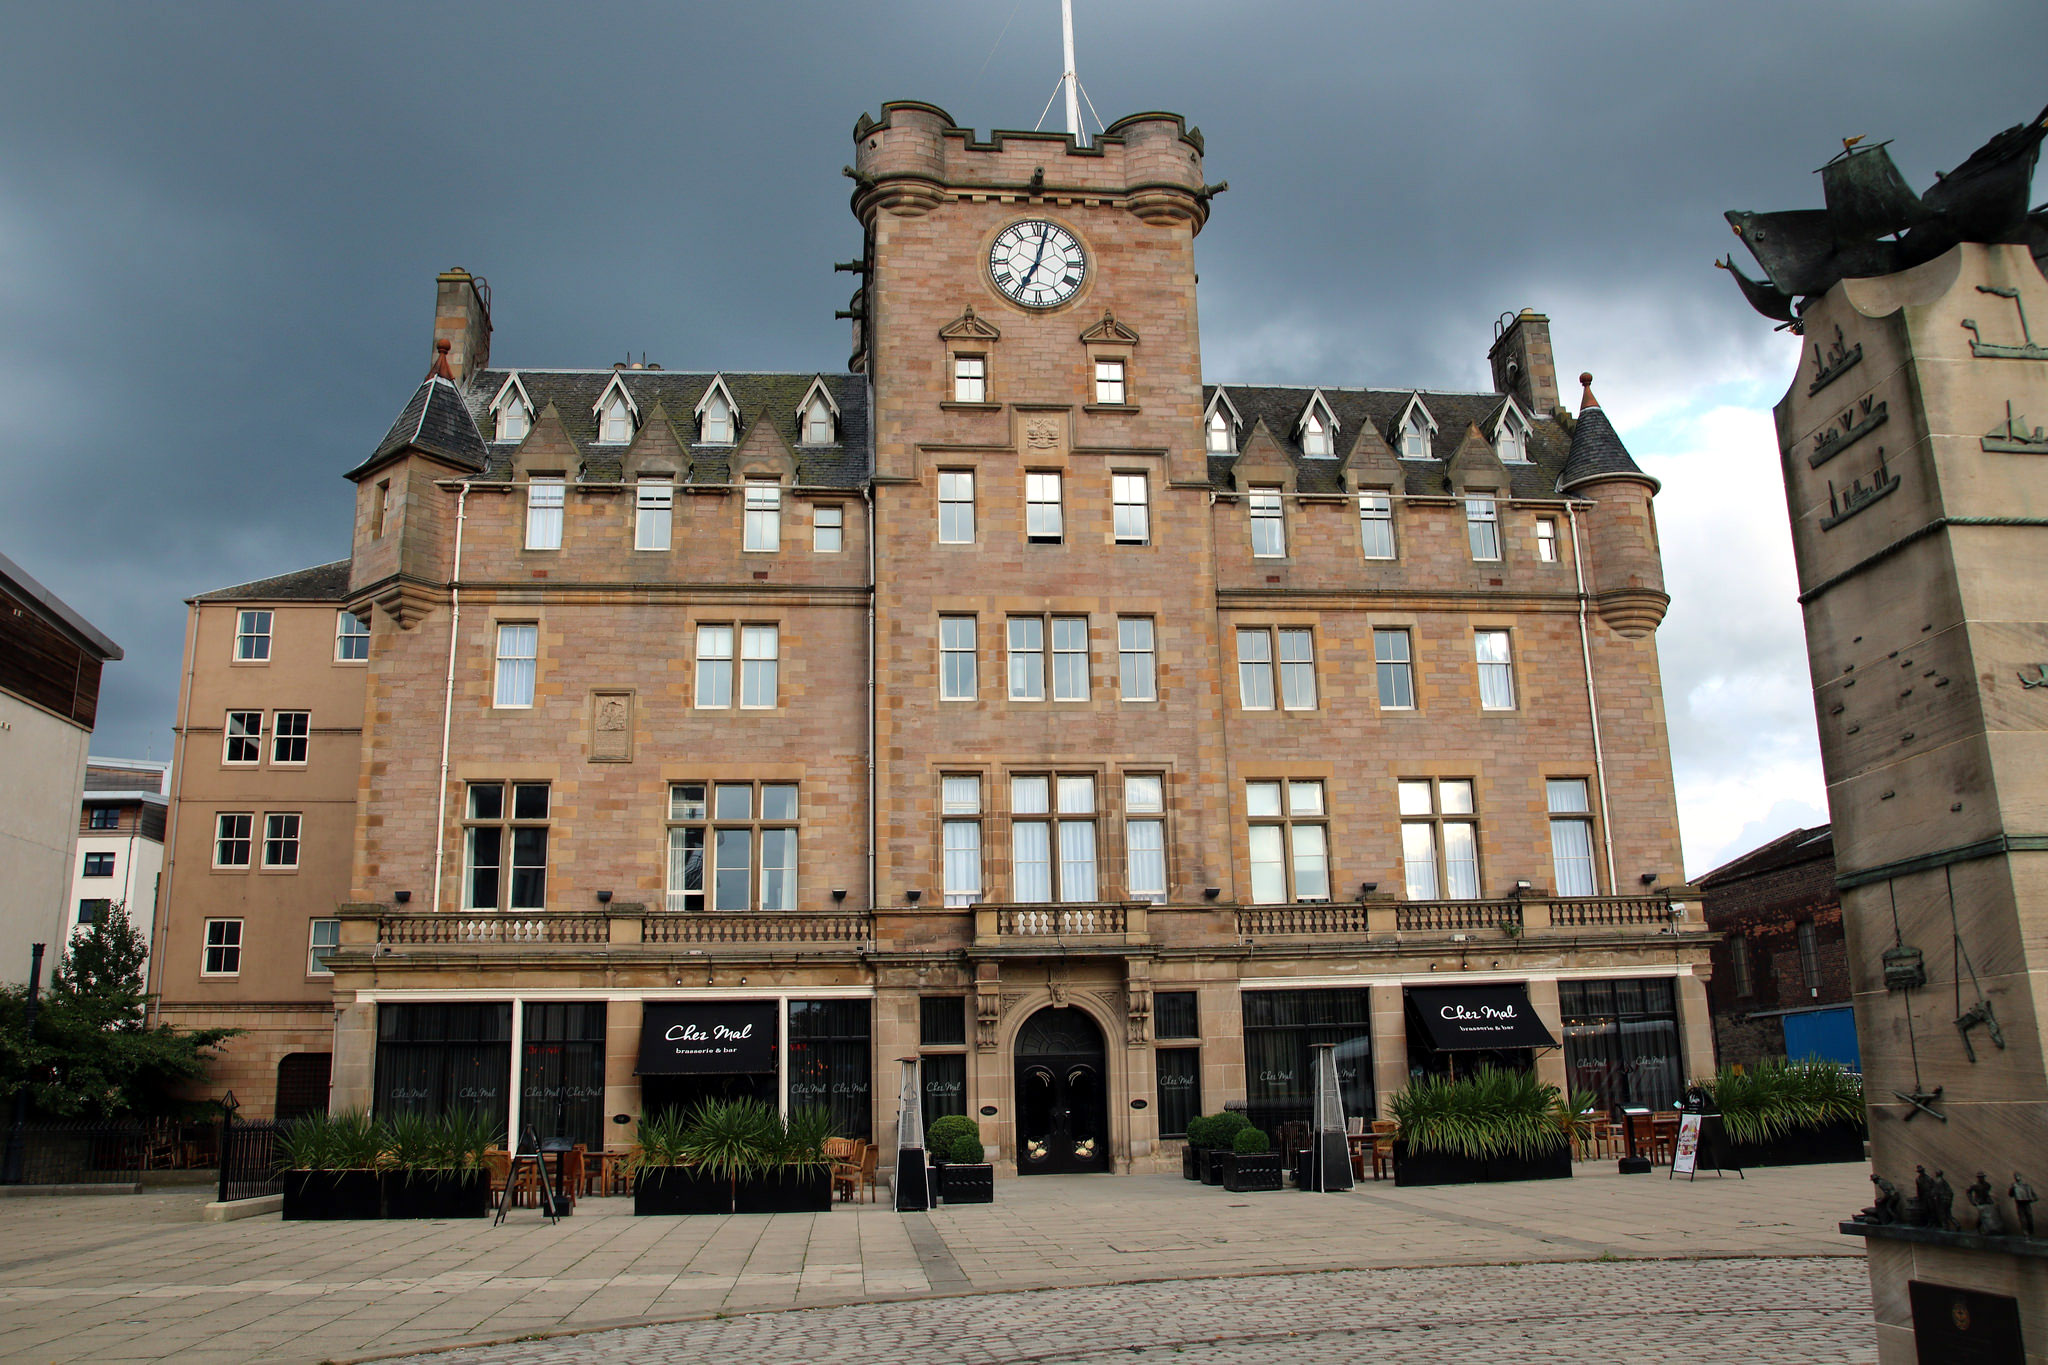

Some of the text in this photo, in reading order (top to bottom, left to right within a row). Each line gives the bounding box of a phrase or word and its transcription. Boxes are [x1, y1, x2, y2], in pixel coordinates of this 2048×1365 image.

[1440, 1004, 1517, 1021] Chez Mal
[665, 1023, 752, 1042] Chez Mal
[675, 1047, 714, 1055] brasserie
